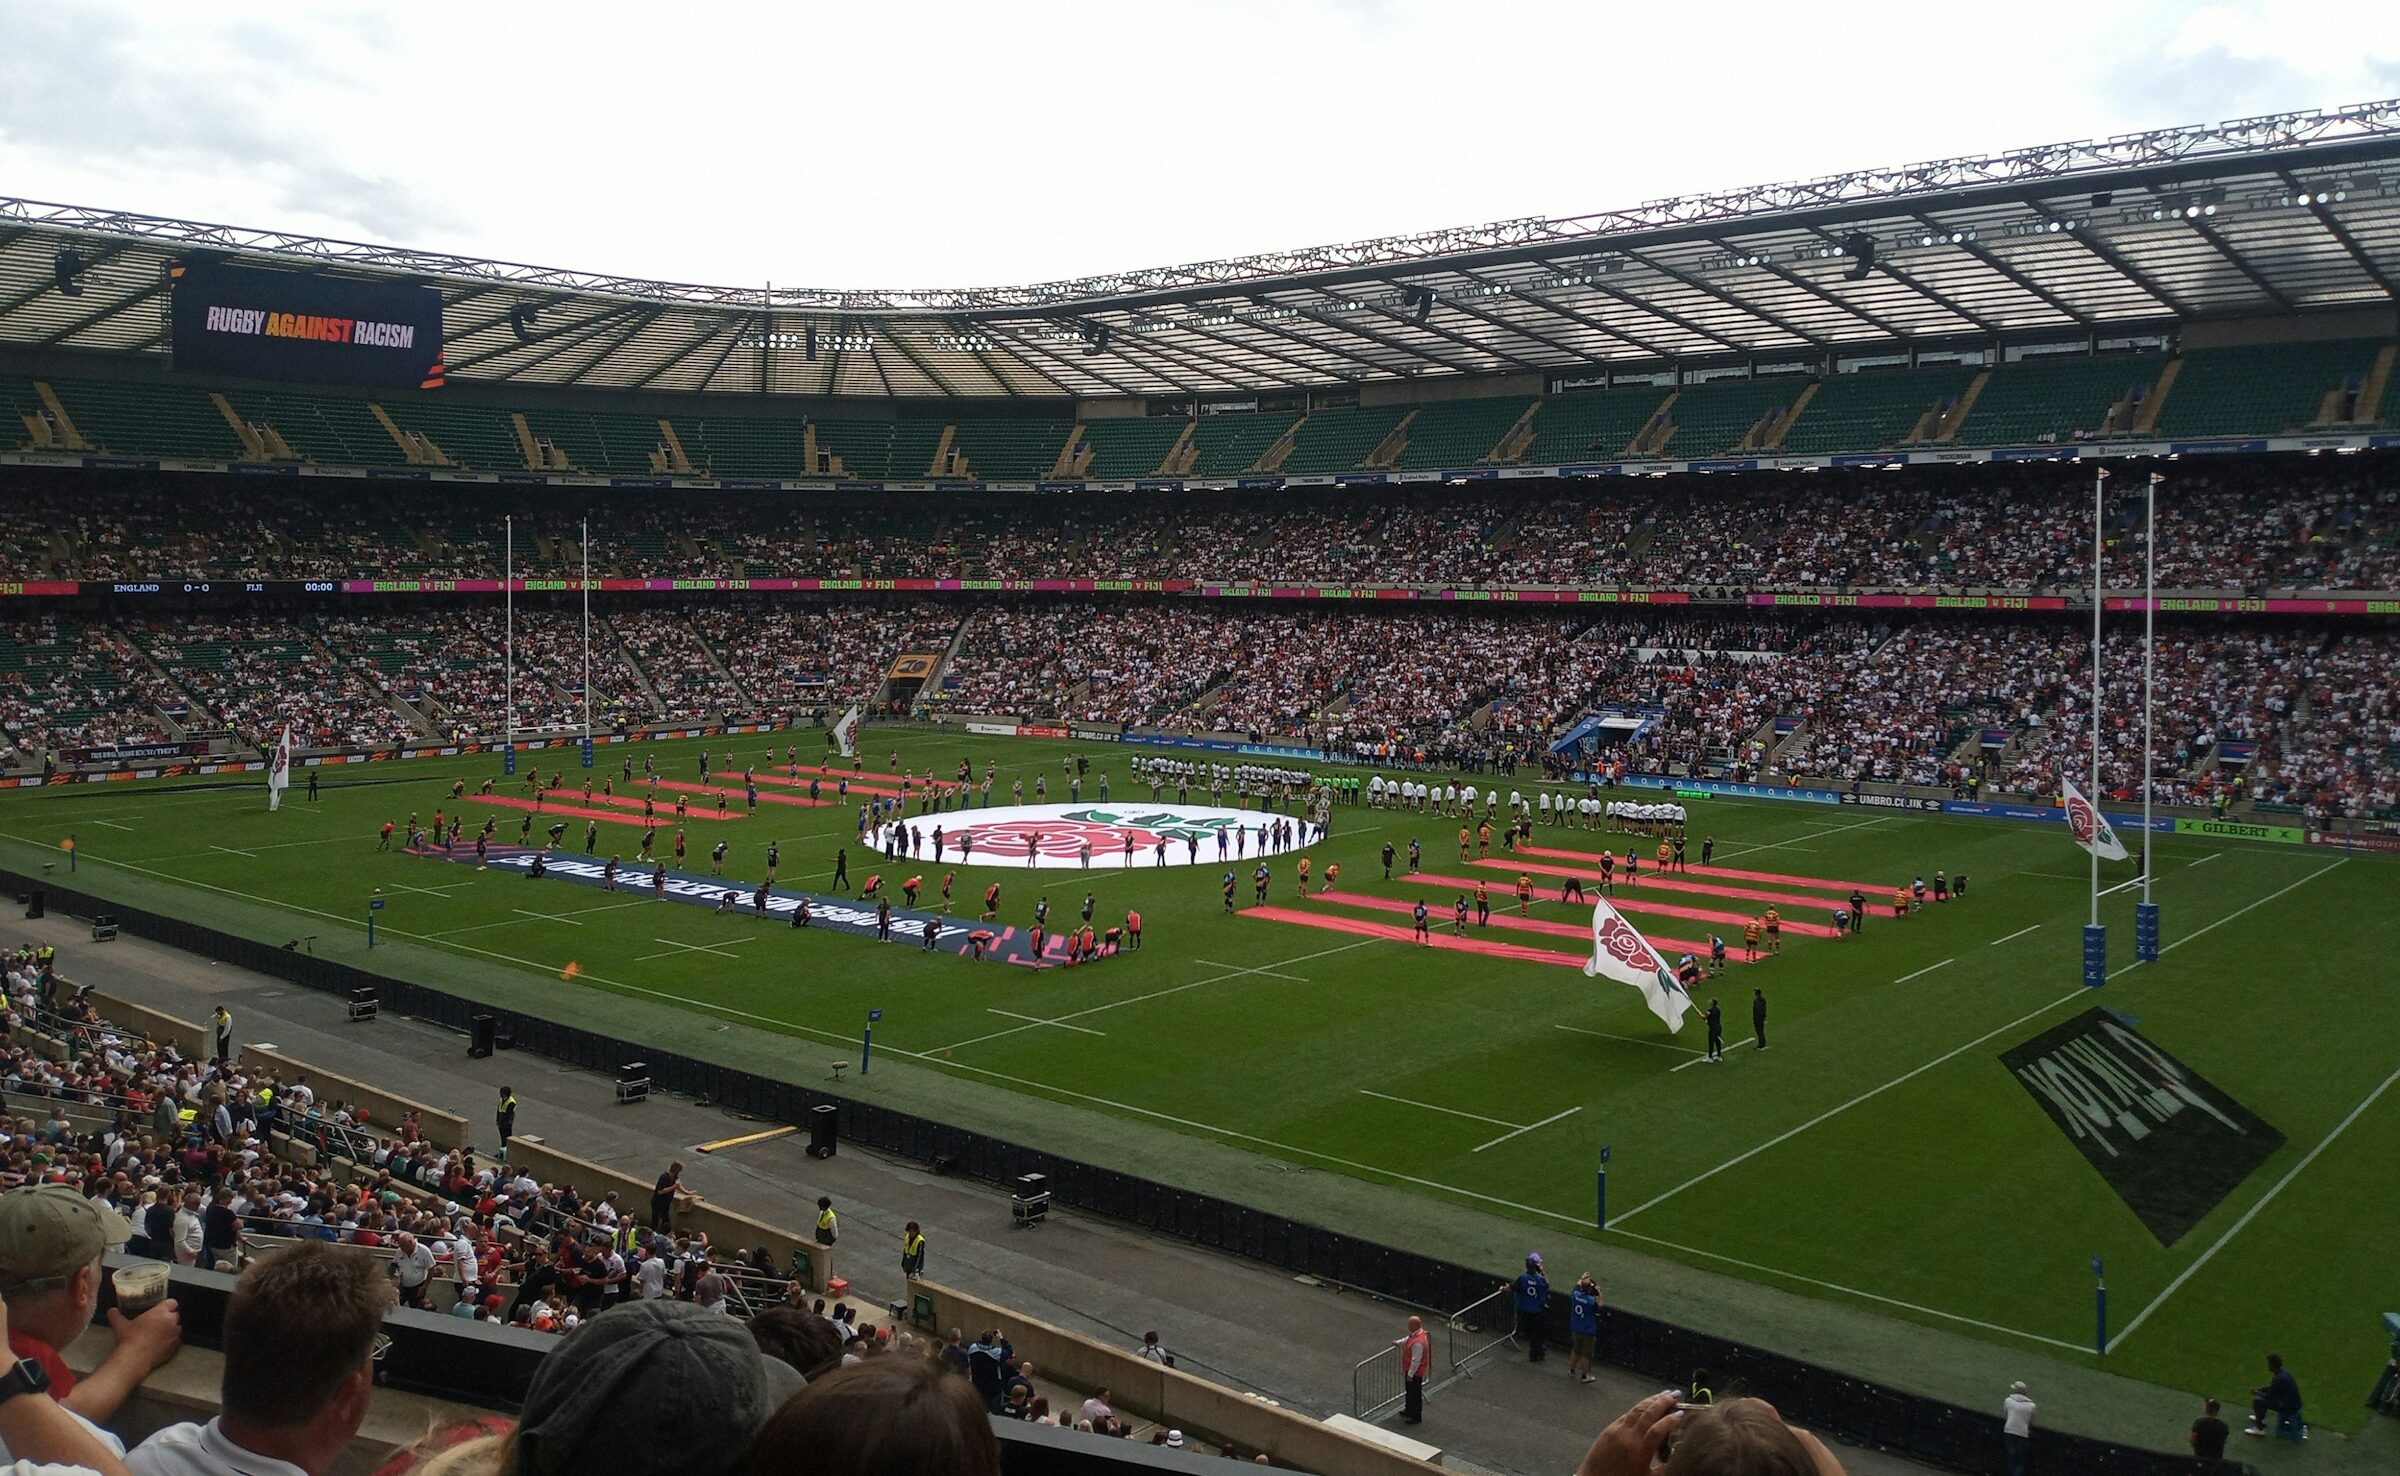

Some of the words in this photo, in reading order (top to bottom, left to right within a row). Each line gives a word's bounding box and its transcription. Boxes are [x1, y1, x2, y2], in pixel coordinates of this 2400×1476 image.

[207, 306, 265, 336] RUGBY
[265, 312, 353, 344] AGAINST
[354, 321, 415, 348] RACISM
[114, 584, 159, 593] ENGLAND
[246, 584, 263, 592] FIJI
[304, 583, 333, 592] 00:00
[374, 582, 420, 592] ENGLAND
[434, 582, 456, 592] FIJI
[525, 581, 567, 591] ENGLAND
[581, 581, 602, 591] FIJI
[673, 580, 716, 589] ENGLAND
[729, 580, 750, 589] FIJI
[819, 580, 862, 589] ENGLAND
[875, 580, 896, 589] FIJI
[960, 580, 1002, 590] ENGLAND
[1015, 580, 1033, 590] FIJI
[1094, 582, 1133, 591] ENGLAND
[1144, 582, 1162, 591] FIJI
[1455, 591, 1491, 600] ENGLAND
[1501, 591, 1519, 600] FIJI
[1578, 593, 1618, 602] ENGLAND
[1630, 593, 1649, 602] FIJI
[1775, 595, 1821, 605] ENGLAND
[1835, 595, 1857, 605] FIJI
[1936, 597, 1988, 608] ENGLAND
[2003, 597, 2028, 608] FIJI
[2160, 600, 2219, 611] ENGLAND
[2238, 600, 2266, 611] FIJI
[2202, 822, 2269, 837] GILBERT
[2368, 840, 2400, 849] HOSPI
